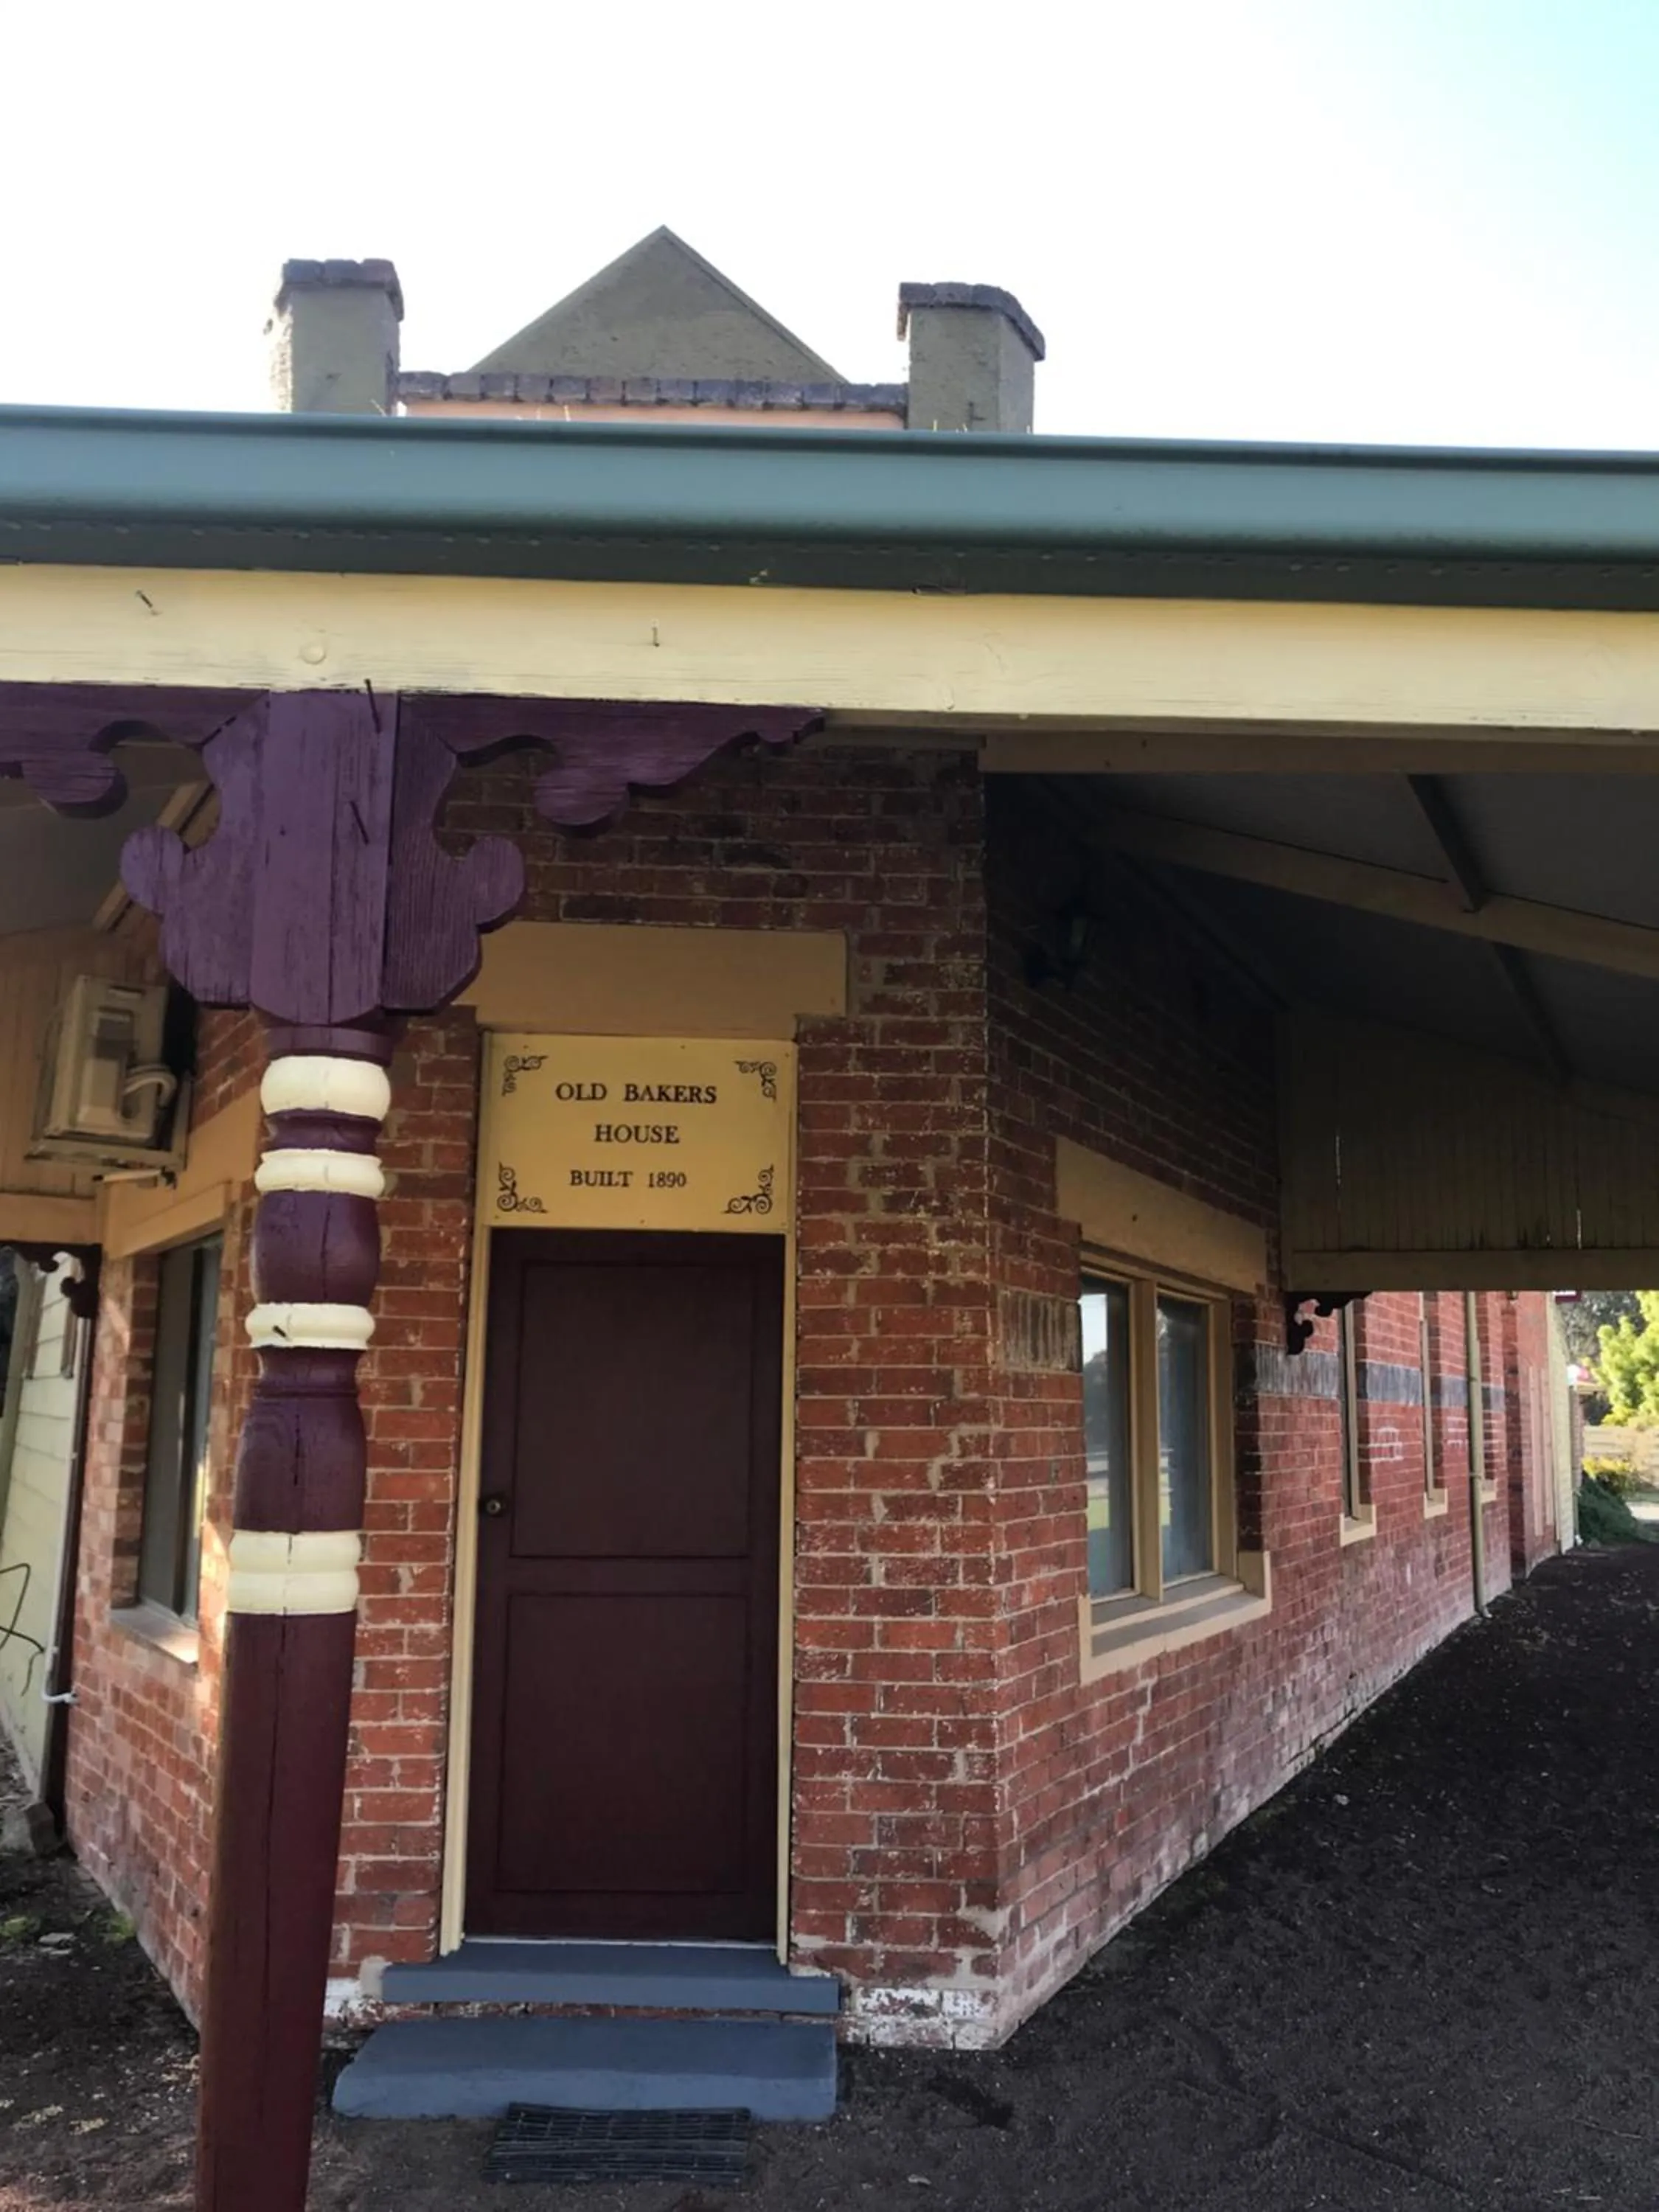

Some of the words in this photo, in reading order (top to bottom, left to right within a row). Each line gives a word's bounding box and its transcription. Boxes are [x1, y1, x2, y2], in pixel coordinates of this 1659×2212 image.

[555, 1082, 608, 1101] OLD
[624, 1084, 717, 1104] BAKERS
[594, 1124, 680, 1144] HOUSE
[570, 1170, 633, 1187] BUILT
[648, 1172, 687, 1188] 1890
